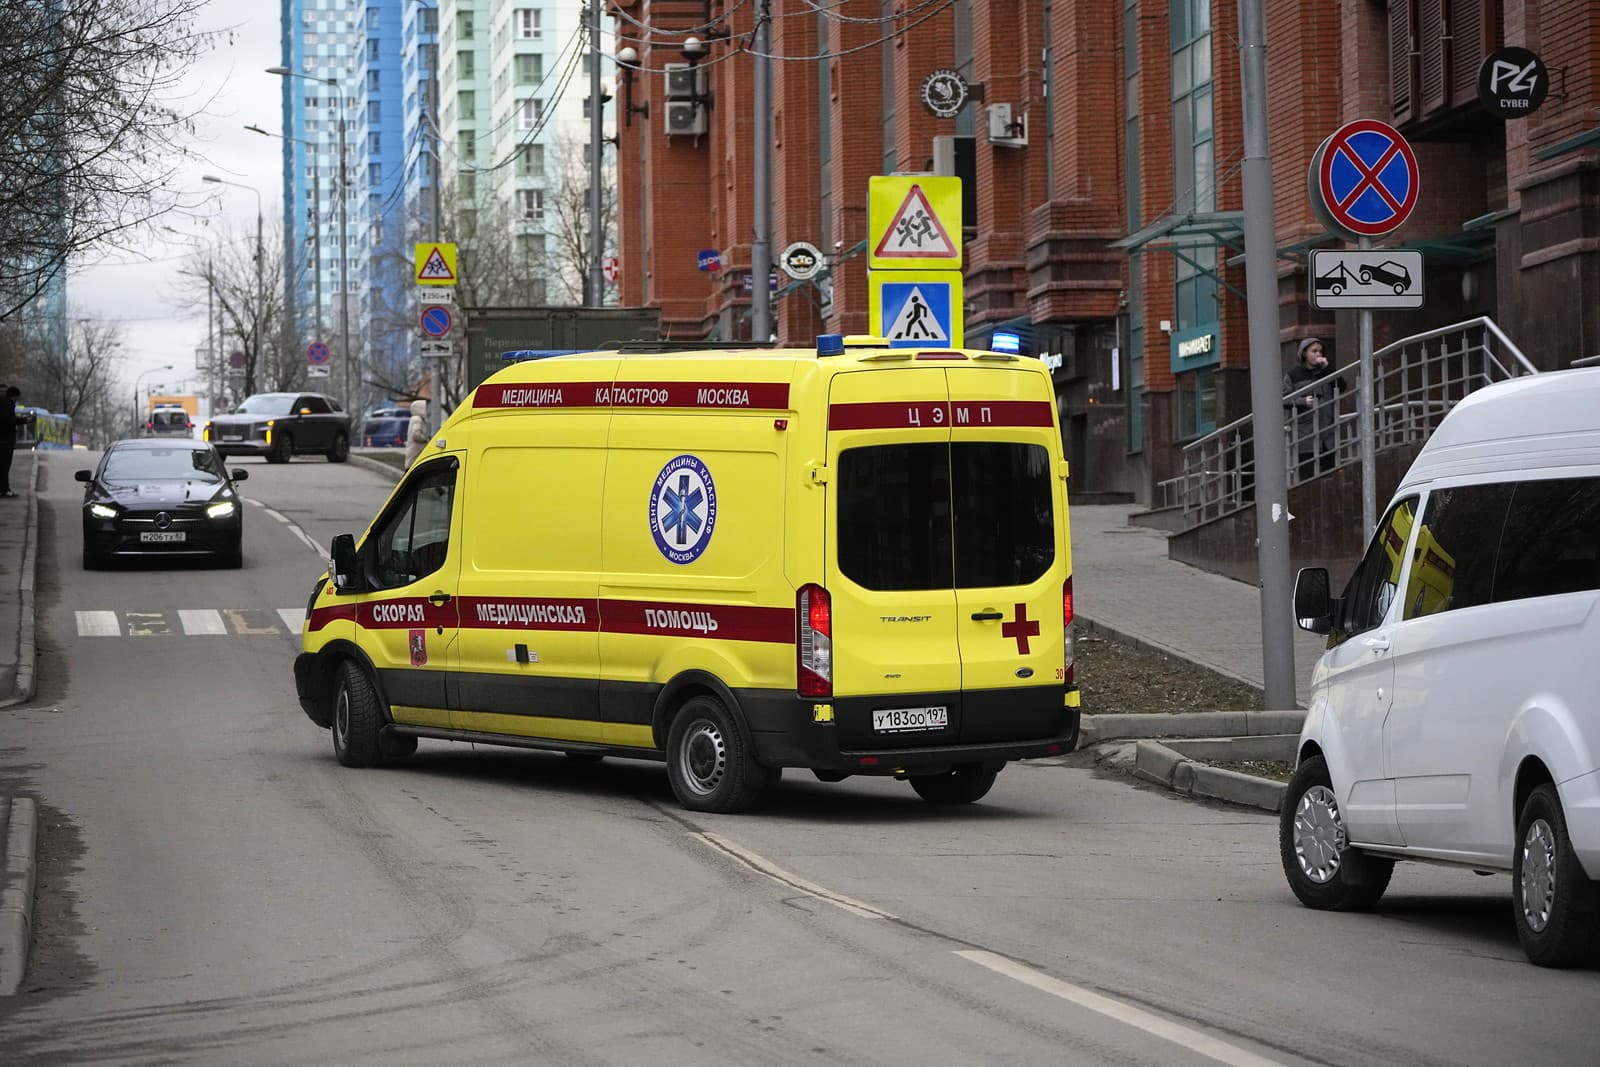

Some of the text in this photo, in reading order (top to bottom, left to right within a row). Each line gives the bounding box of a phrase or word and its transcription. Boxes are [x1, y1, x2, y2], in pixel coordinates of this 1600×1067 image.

[1490, 60, 1538, 96] PG
[1500, 99, 1529, 108] CYBER
[502, 388, 750, 406] МЕДИЦИНА КАТАСТРОФ МОСКВА
[650, 458, 716, 534] ЦЕНТР МЕДИЦИНЫ КАТАСТРОФ
[669, 550, 694, 561] МОСКВА
[373, 603, 718, 634] СКОРАЯ МЕДИЦИНСКАЯ ПОМОЩЬ
[1055, 668, 1064, 680] 30
[926, 708, 944, 720] 197
